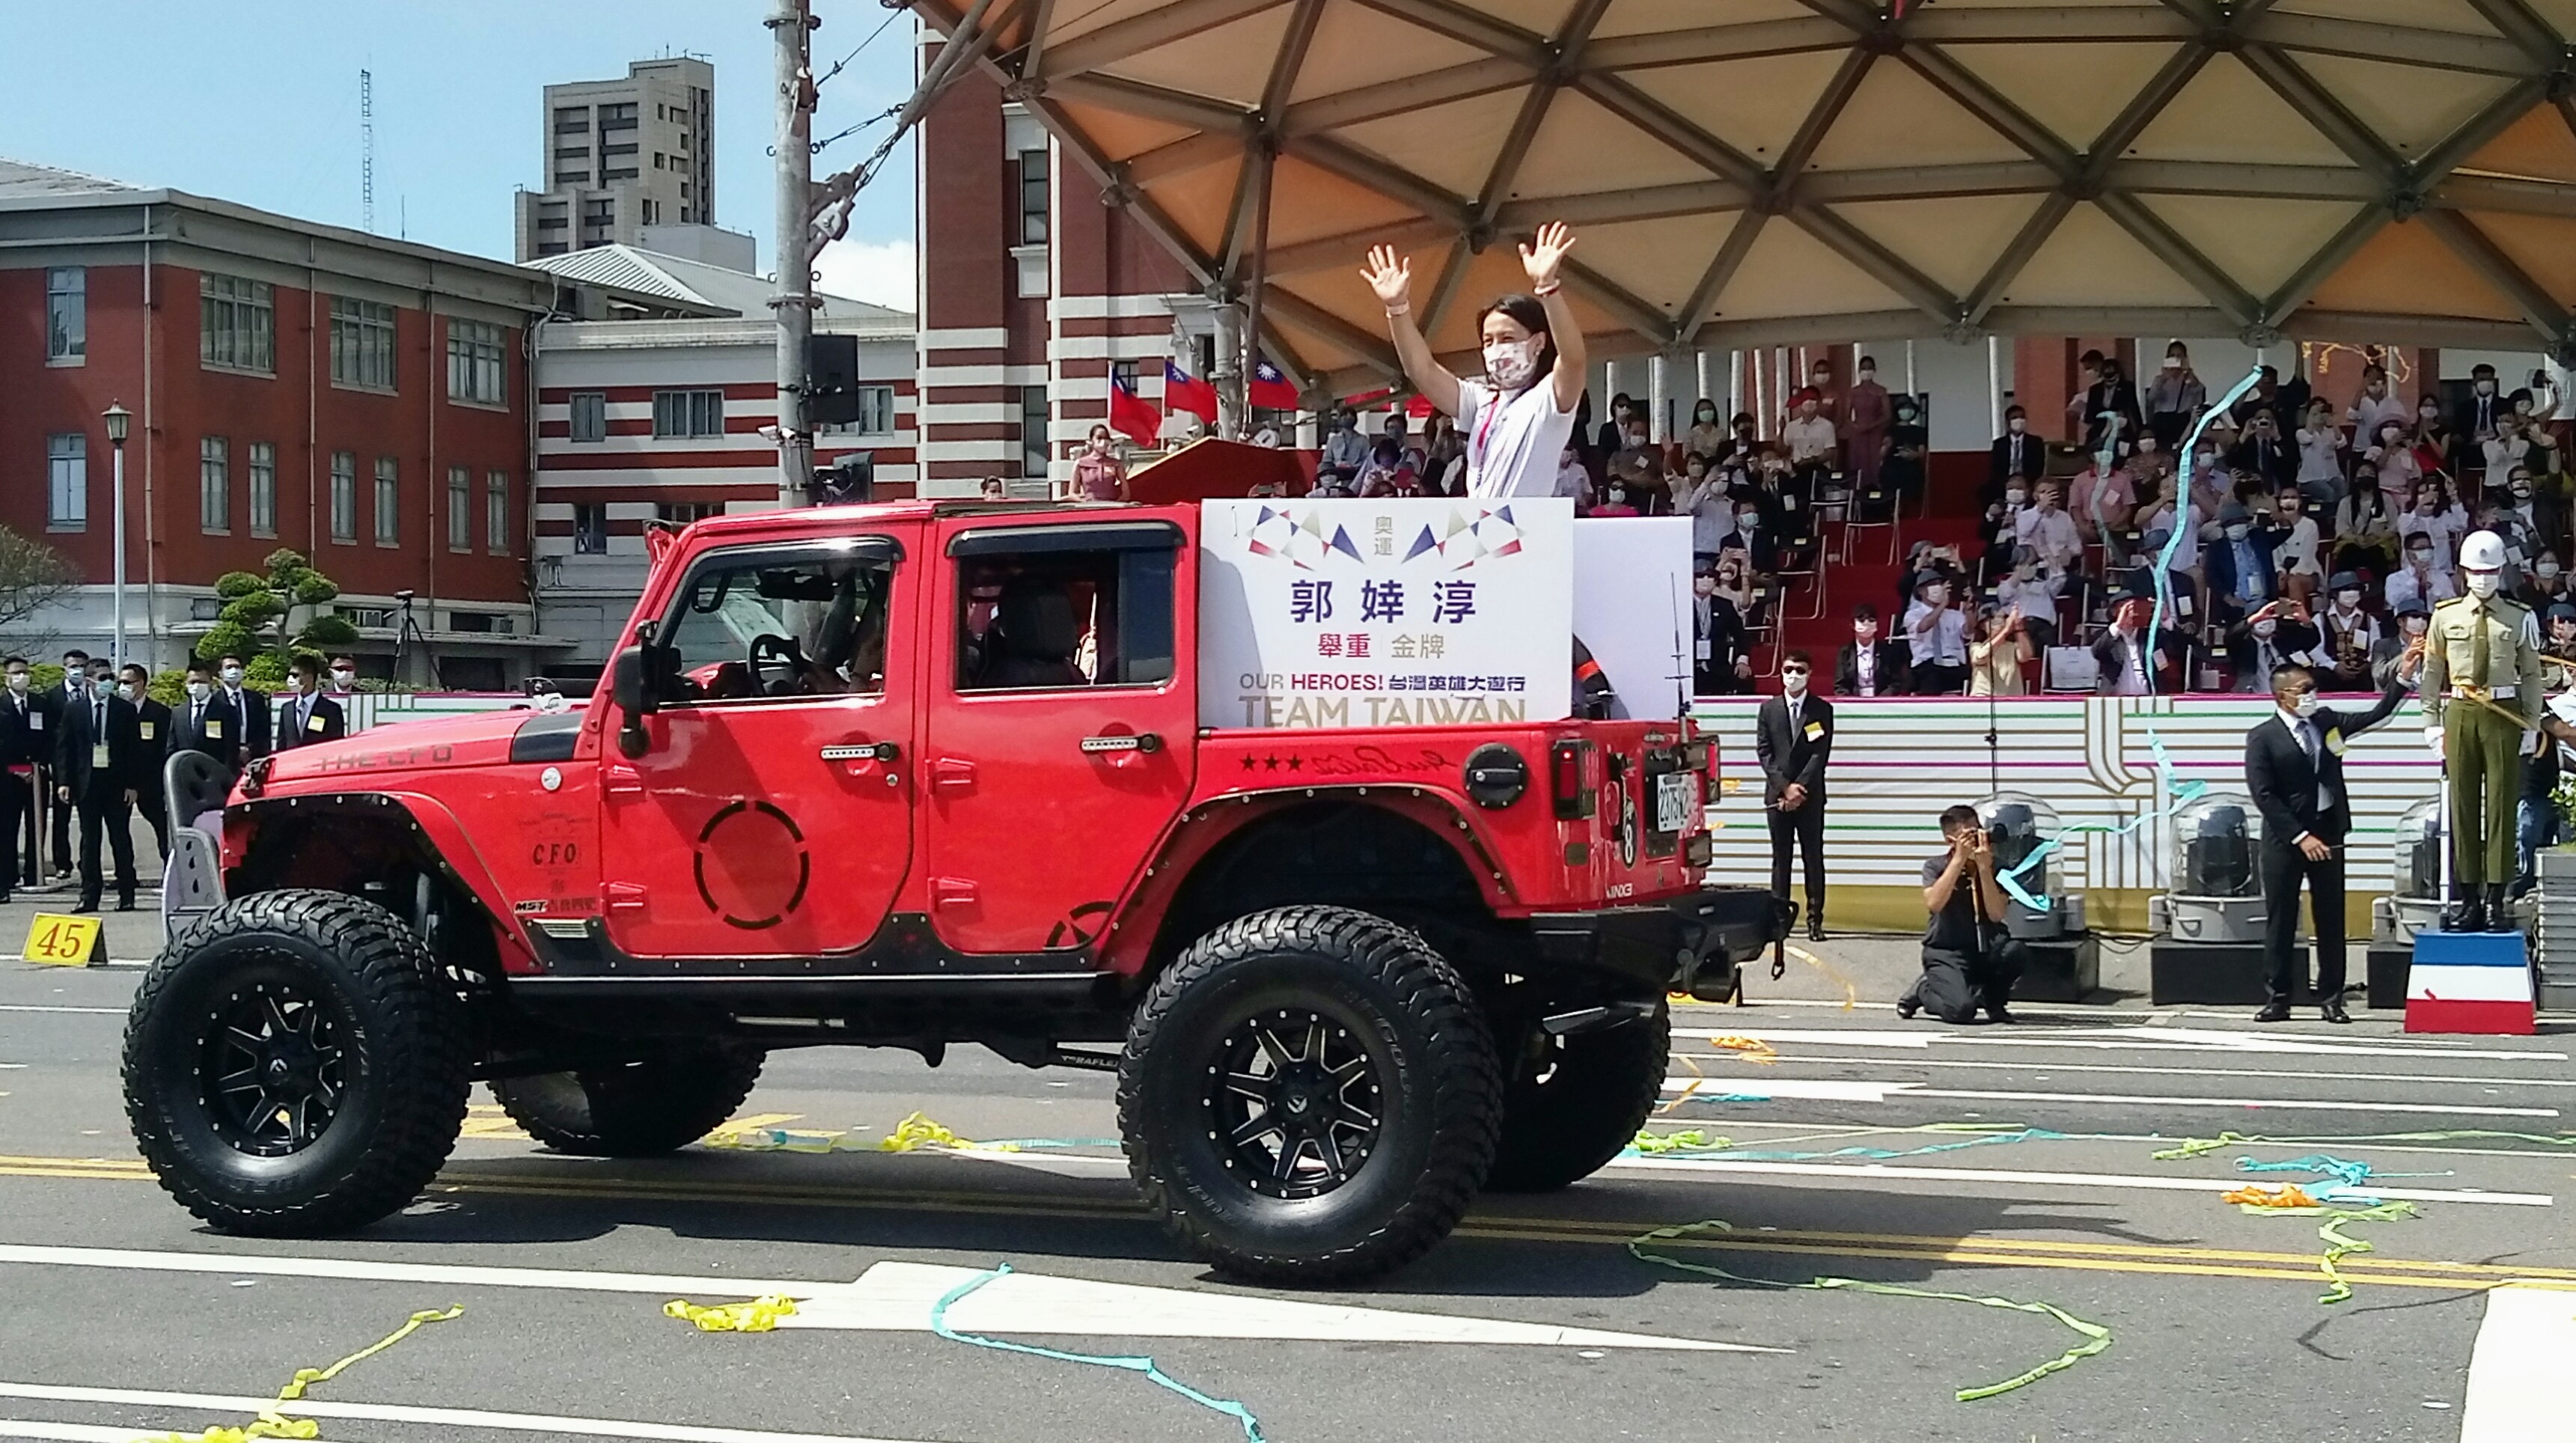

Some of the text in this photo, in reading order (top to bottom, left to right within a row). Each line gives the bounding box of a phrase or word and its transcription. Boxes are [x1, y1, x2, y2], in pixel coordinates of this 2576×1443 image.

[1374, 515, 1393, 555] 奧運
[1290, 579, 1476, 623] 郭婞淳
[1317, 632, 1445, 659] 舉重 金牌
[1239, 673, 1525, 692] OUR HEROES! 台灣英雄大遊行
[1238, 695, 1525, 728] TEAM TAIWAN
[533, 843, 576, 865] CFO
[1625, 823, 1633, 864] 8
[37, 923, 85, 958] 45
